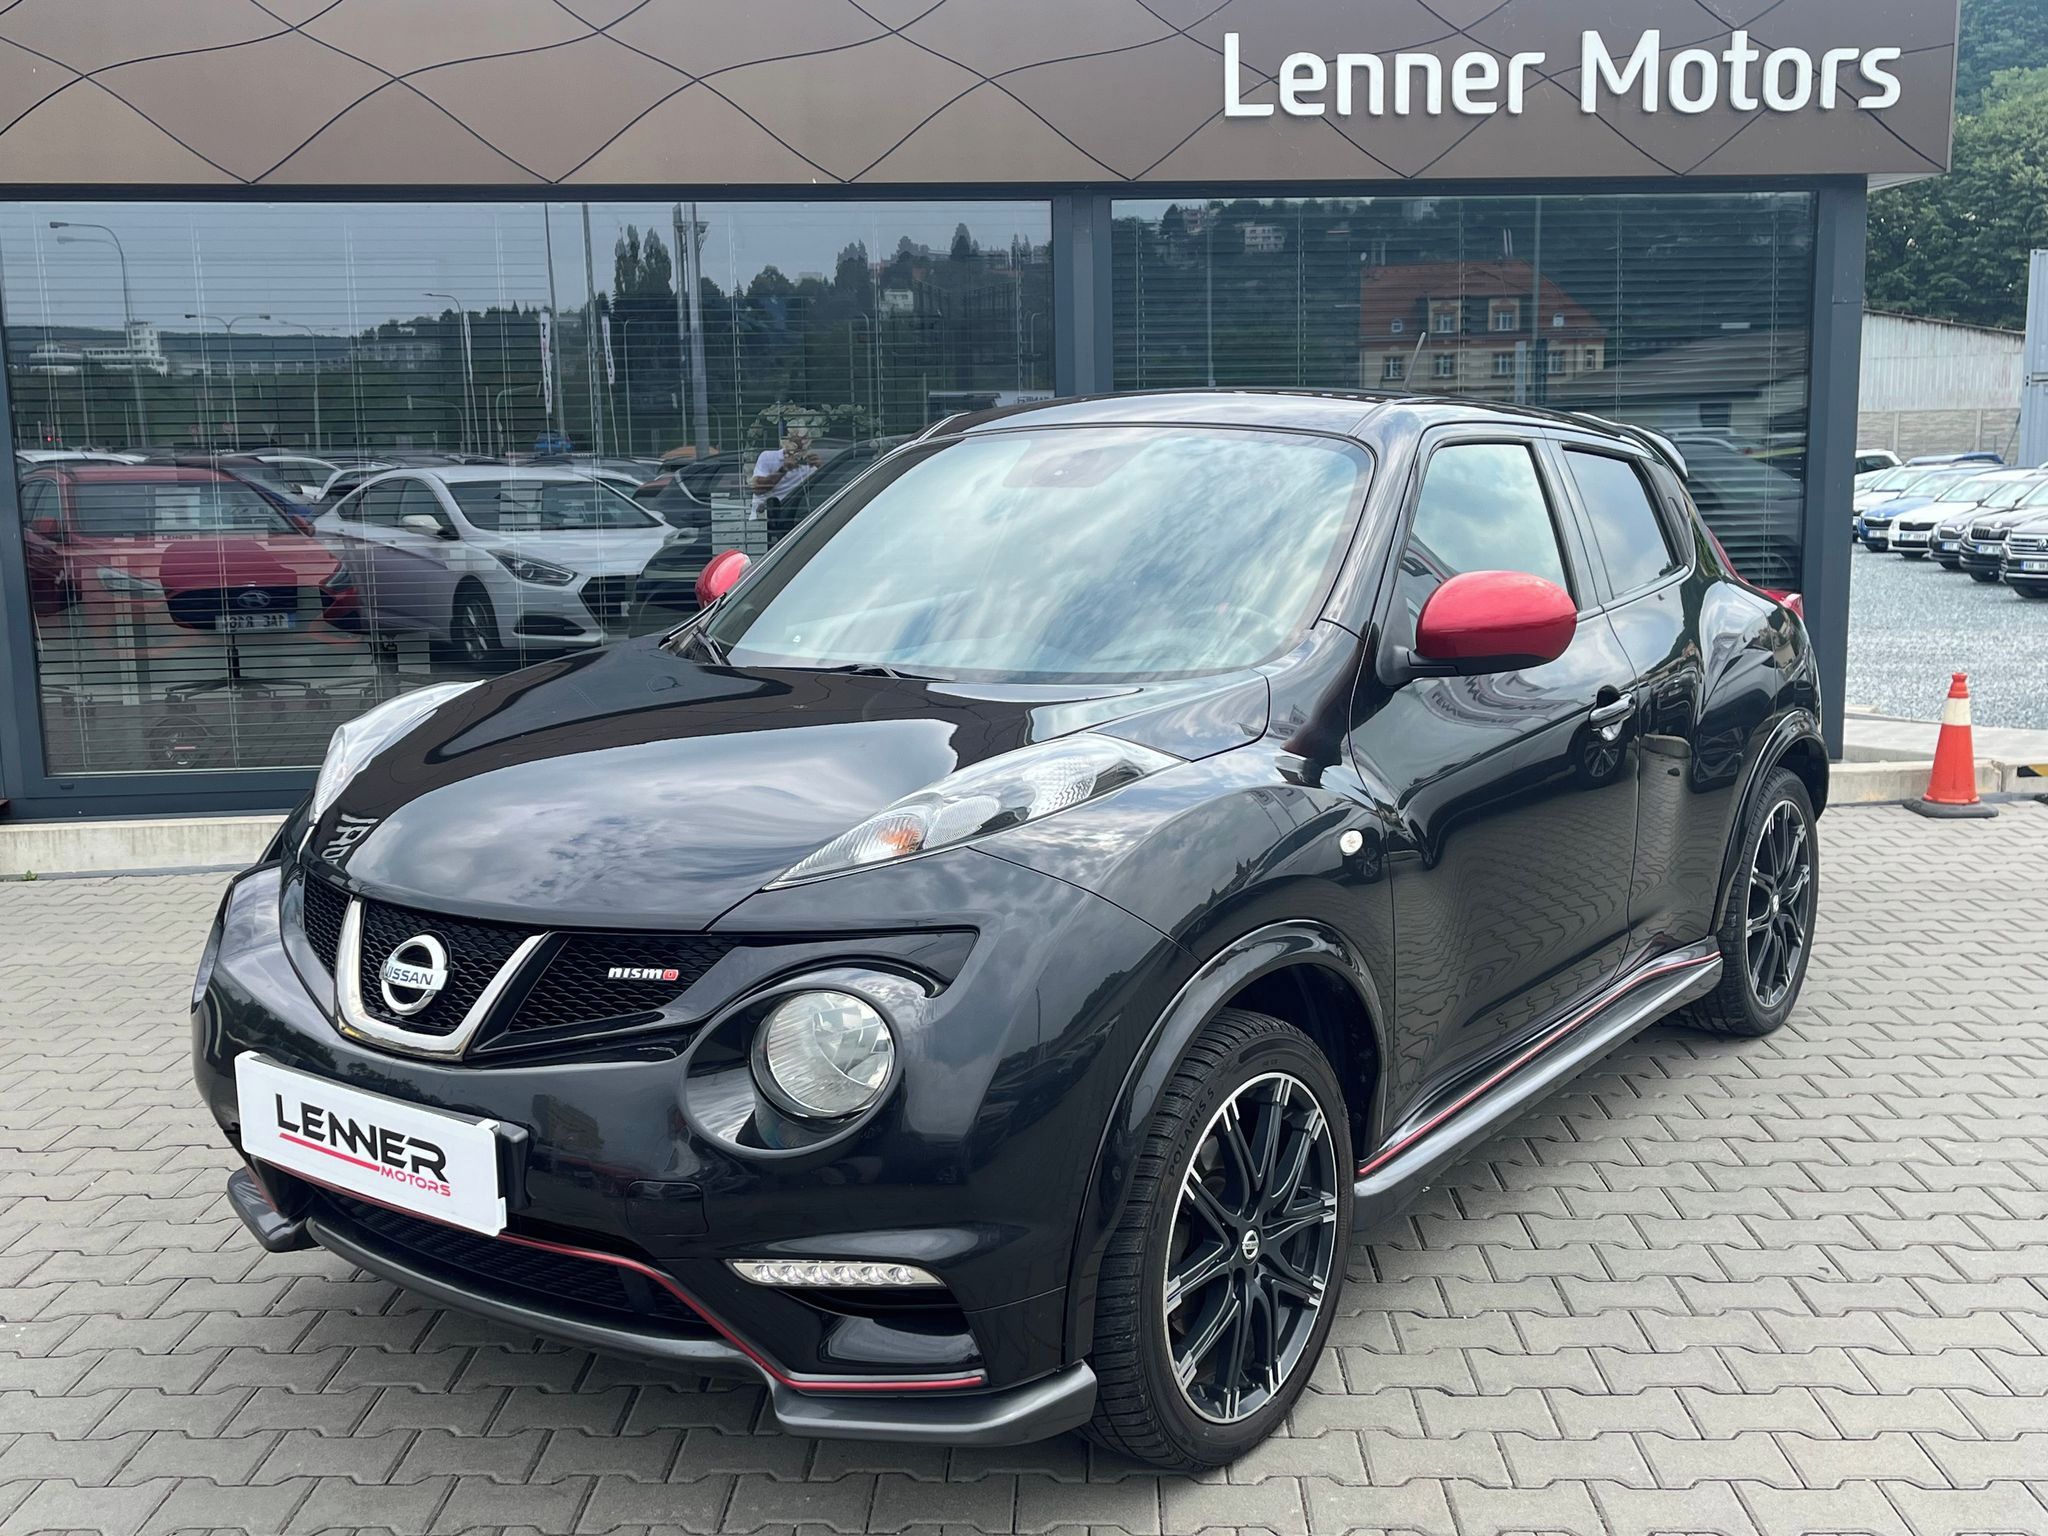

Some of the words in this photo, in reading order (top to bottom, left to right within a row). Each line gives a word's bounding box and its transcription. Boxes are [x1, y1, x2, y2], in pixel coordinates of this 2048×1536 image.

[1224, 31, 1546, 117] Lenner
[1580, 29, 1902, 115] Motors
[384, 962, 434, 986] NISSAN
[275, 1093, 450, 1184] LENNER
[1168, 1101, 1207, 1177] POLARIS
[380, 1165, 452, 1198] MOTORS
